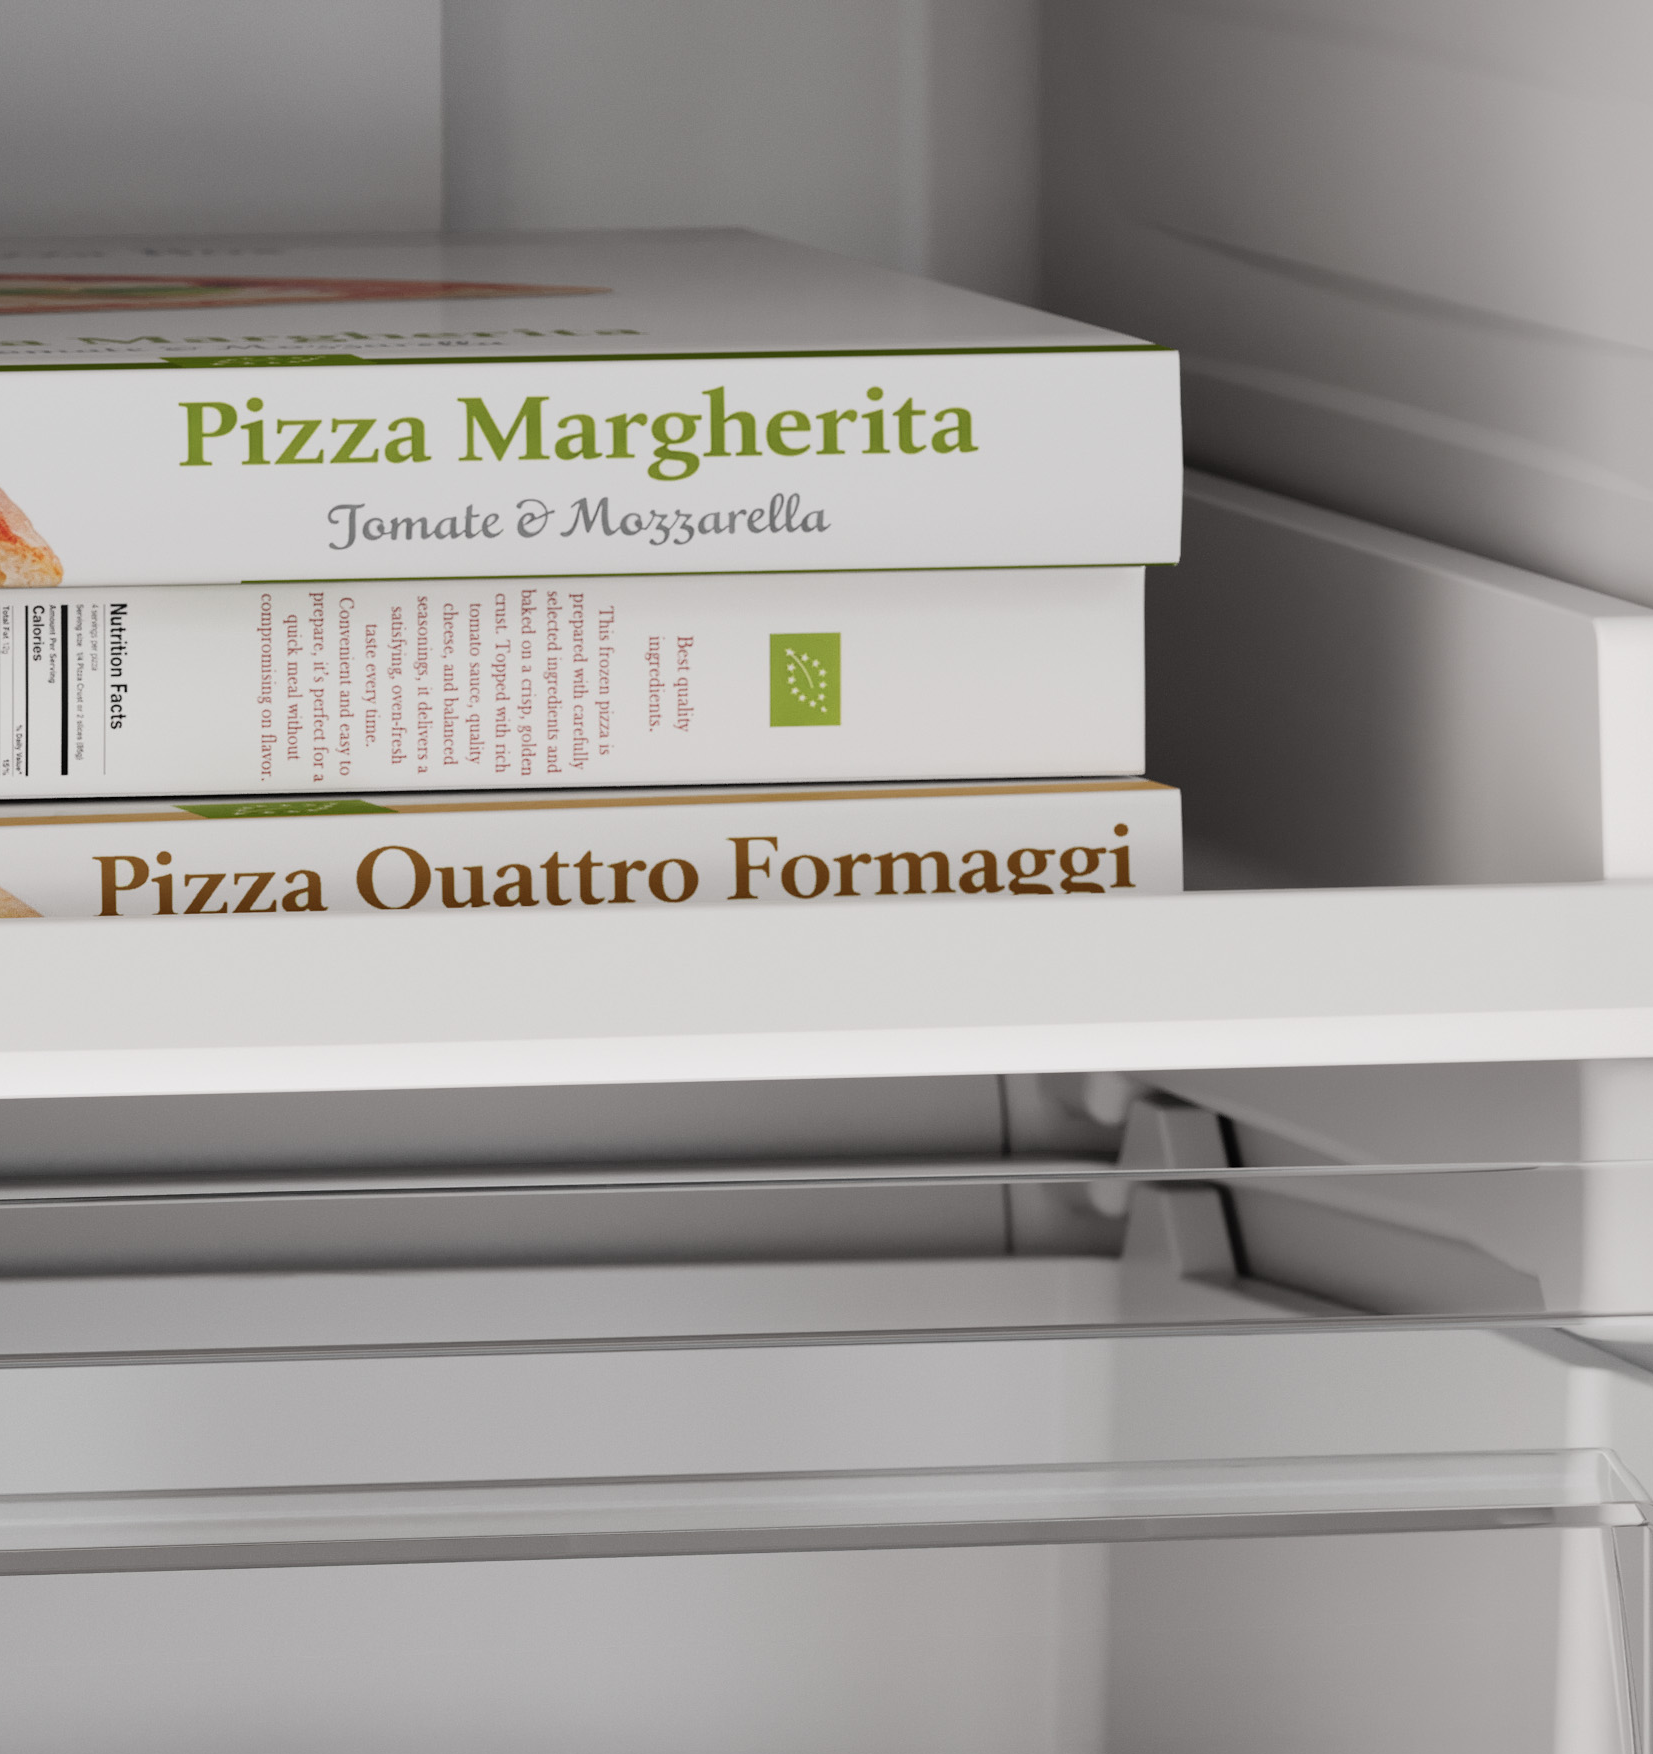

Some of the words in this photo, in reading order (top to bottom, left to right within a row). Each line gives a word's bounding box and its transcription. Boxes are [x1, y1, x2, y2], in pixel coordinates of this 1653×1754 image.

[178, 397, 432, 466] Pizza
[457, 386, 980, 482] Margherita
[326, 503, 503, 551] Tomate
[515, 498, 556, 539] &
[558, 492, 832, 546] Mozzarella
[2, 606, 10, 625] Total
[74, 604, 84, 631] Serving
[89, 610, 99, 638] servings
[309, 592, 324, 656] prepare,
[441, 603, 459, 658] cheese,
[469, 603, 482, 656] tomato
[495, 593, 508, 634] crust.
[521, 589, 538, 635] baked
[546, 591, 563, 652] selected
[569, 593, 588, 663] prepared
[599, 605, 615, 641] This
[32, 605, 45, 661] Calories
[49, 638, 57, 651] Per
[90, 640, 98, 651] per
[110, 603, 128, 677] Nutrition
[257, 593, 277, 704] compromising
[283, 614, 303, 656] quick
[339, 597, 355, 685] Convenient
[365, 624, 378, 658] taste
[387, 606, 407, 679] satisfying,
[413, 596, 433, 680] seasonings,
[521, 640, 532, 659] on
[47, 653, 57, 683] Serving
[76, 663, 84, 681] Pizza
[89, 653, 98, 671] pizza
[491, 639, 511, 701] Topped
[521, 665, 532, 673] a
[599, 647, 615, 695] frozen
[677, 636, 694, 671] Best
[76, 683, 85, 702] Crust
[287, 662, 304, 698] meal
[361, 663, 376, 704] every
[417, 687, 433, 696] it
[443, 664, 458, 692] and
[466, 662, 480, 708] sauce,
[573, 668, 589, 699] with
[645, 636, 665, 732] ingredients.
[110, 684, 128, 729] Facts
[261, 709, 272, 728] on
[309, 689, 329, 741] perfect
[339, 691, 354, 718] and
[517, 679, 537, 719] crisp,
[544, 657, 562, 740] ingredients
[674, 677, 694, 732] quality
[76, 720, 84, 740] slices
[287, 704, 303, 760] without
[335, 724, 350, 755] easy
[365, 709, 381, 747] time.
[391, 685, 407, 764] oven-fresh
[417, 702, 433, 760] delivers
[443, 697, 459, 765] balanced
[465, 714, 485, 764] quality
[495, 706, 511, 738] with
[569, 705, 589, 770] carefully
[595, 701, 614, 738] pizza
[15, 733, 23, 750] Daily
[261, 734, 277, 781] flavor.
[313, 747, 329, 768] for
[495, 744, 511, 773] rich
[517, 725, 537, 776] golden
[547, 746, 562, 773] and
[598, 744, 614, 755] is
[2, 759, 10, 776] 15%
[313, 774, 324, 782] a
[339, 761, 351, 776] to
[417, 766, 428, 774] a
[92, 851, 328, 916] Pizza
[727, 823, 1136, 900] Formaggi
